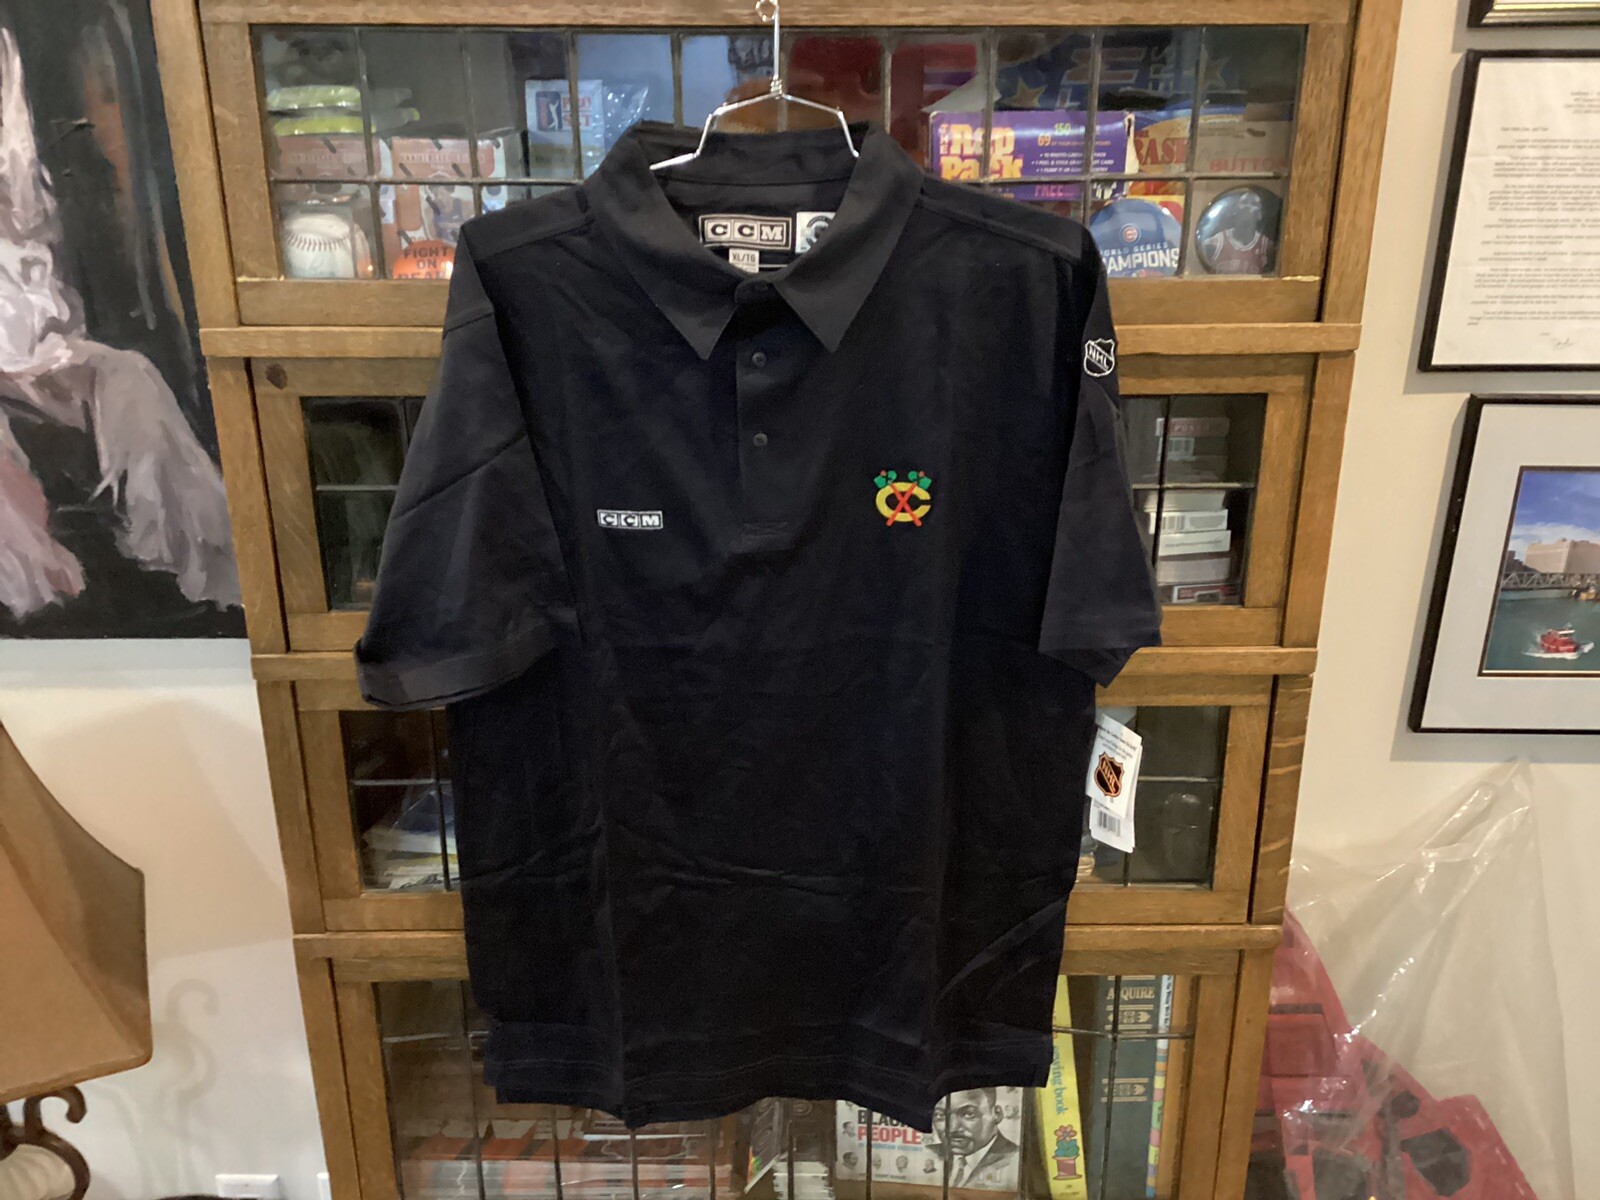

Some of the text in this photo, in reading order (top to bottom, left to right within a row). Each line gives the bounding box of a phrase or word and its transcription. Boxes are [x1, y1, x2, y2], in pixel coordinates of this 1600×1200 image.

[708, 222, 785, 242] CCM
[403, 246, 448, 259] FIGHT
[1133, 241, 1169, 253] SERIES
[416, 258, 437, 269] ON
[1102, 247, 1179, 274] AMPIONS
[600, 511, 661, 528] CCM
[1107, 986, 1155, 1000] AQUIRE
[1055, 1087, 1068, 1116] book
[858, 1126, 922, 1145] PEOPLE
